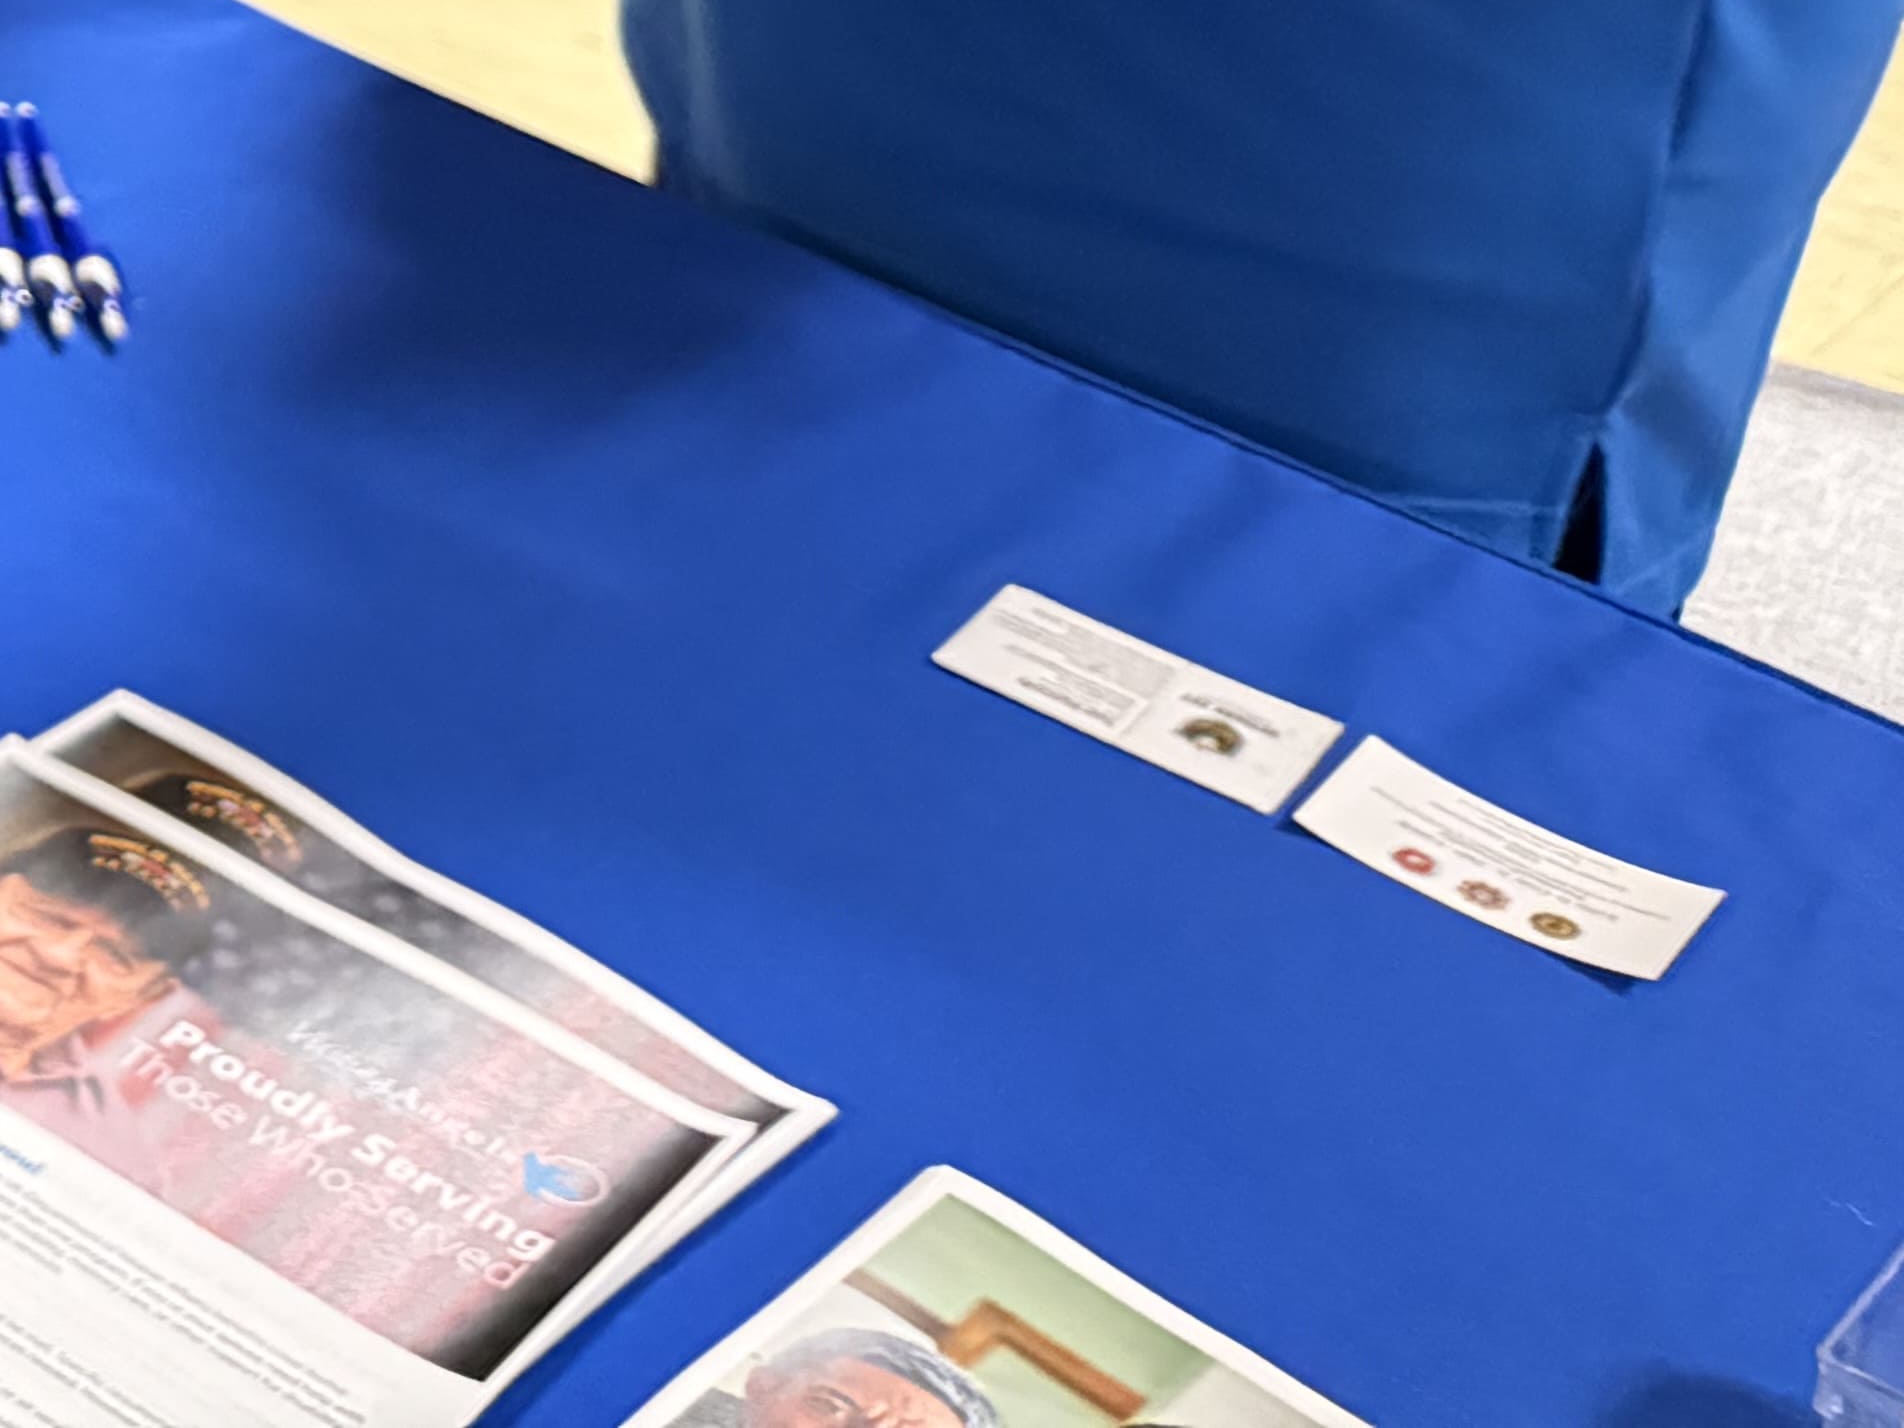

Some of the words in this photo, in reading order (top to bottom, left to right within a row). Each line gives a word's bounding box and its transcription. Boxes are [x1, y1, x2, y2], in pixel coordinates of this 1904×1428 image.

[120, 1036, 248, 1131] Those
[247, 1113, 353, 1193] Who
[350, 1185, 527, 1290] Served
[159, 1019, 355, 1144] Proudly
[351, 1133, 558, 1263] Serving
